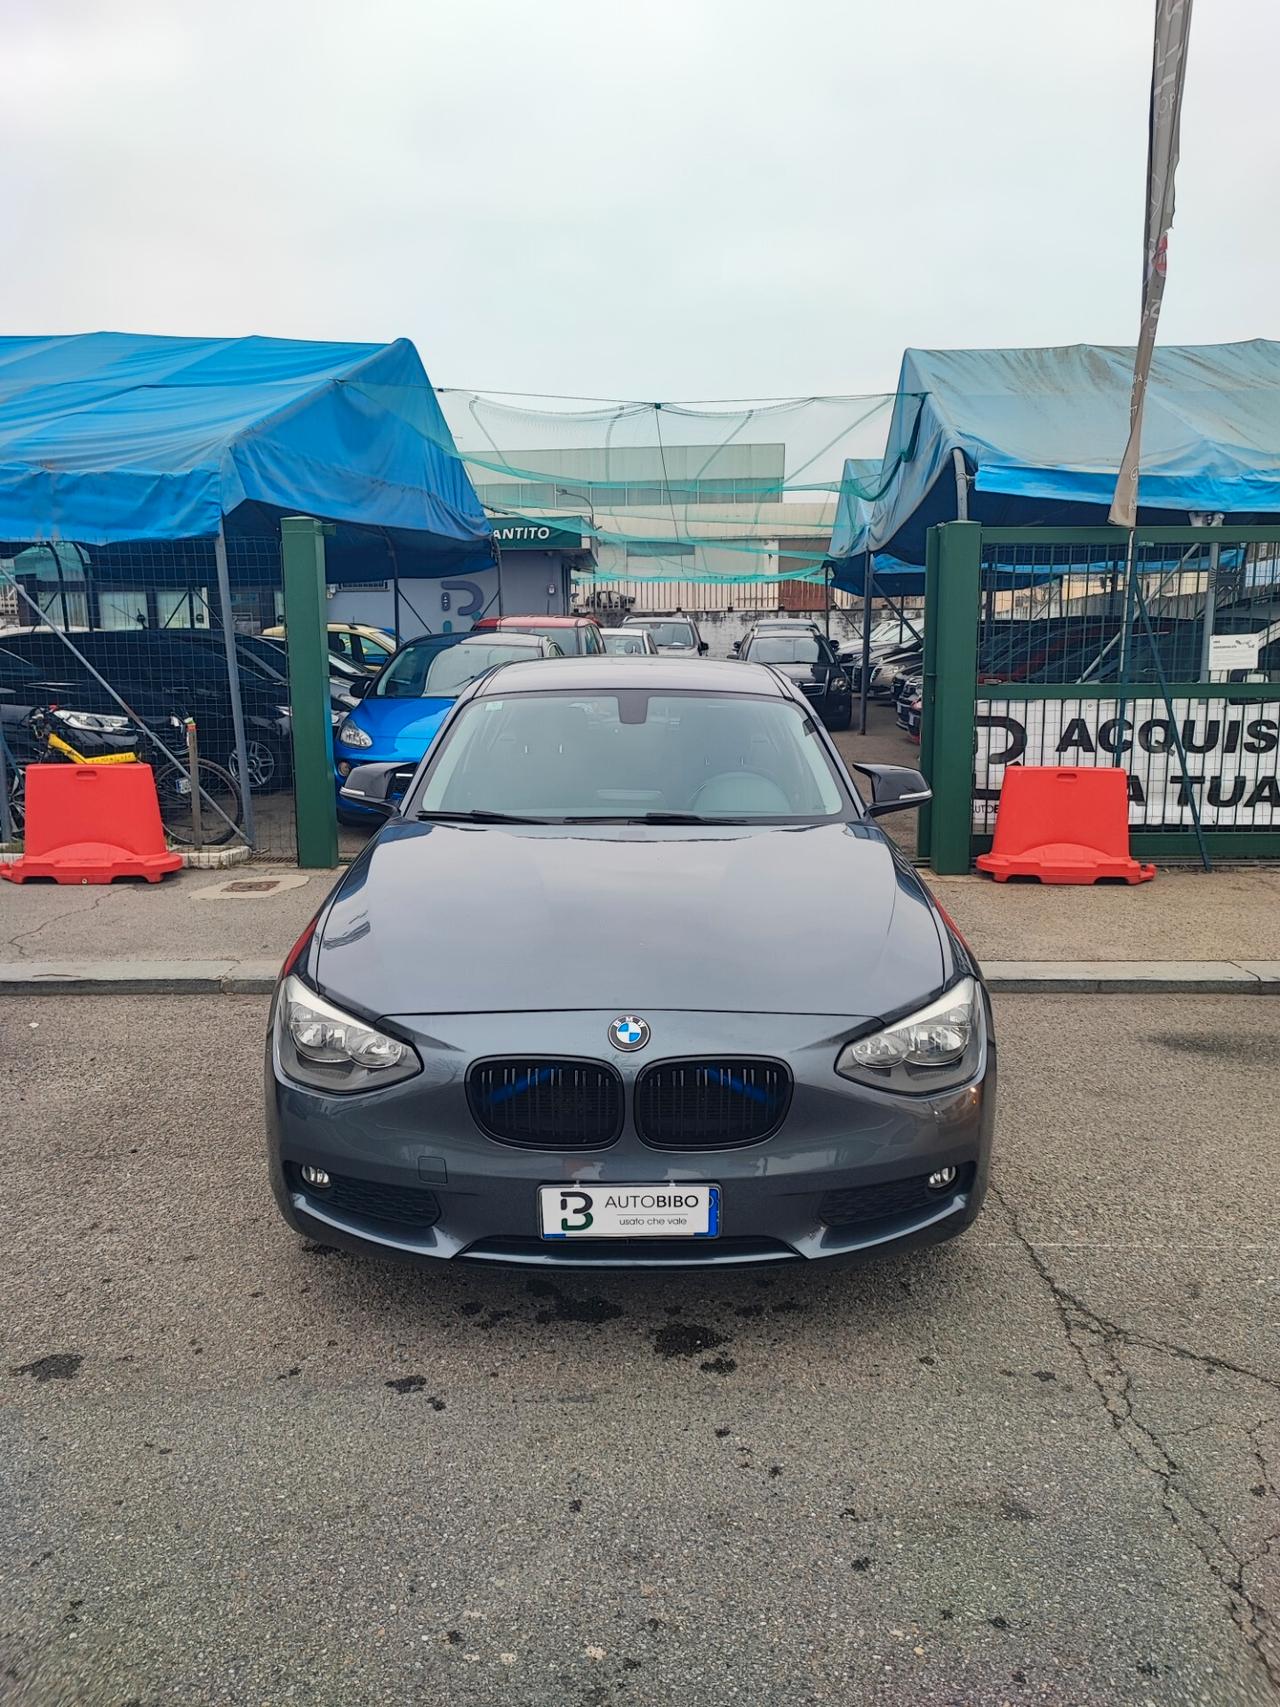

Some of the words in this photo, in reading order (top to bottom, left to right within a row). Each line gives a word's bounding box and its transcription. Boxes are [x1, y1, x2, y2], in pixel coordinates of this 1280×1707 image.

[1055, 717, 1279, 756] ACQUIS
[1169, 775, 1280, 808] TUA
[613, 1016, 647, 1028] BMW
[604, 1195, 699, 1209] AUTOBIBO
[619, 1217, 645, 1226] usato
[646, 1216, 665, 1226] che
[668, 1216, 687, 1226] vale
